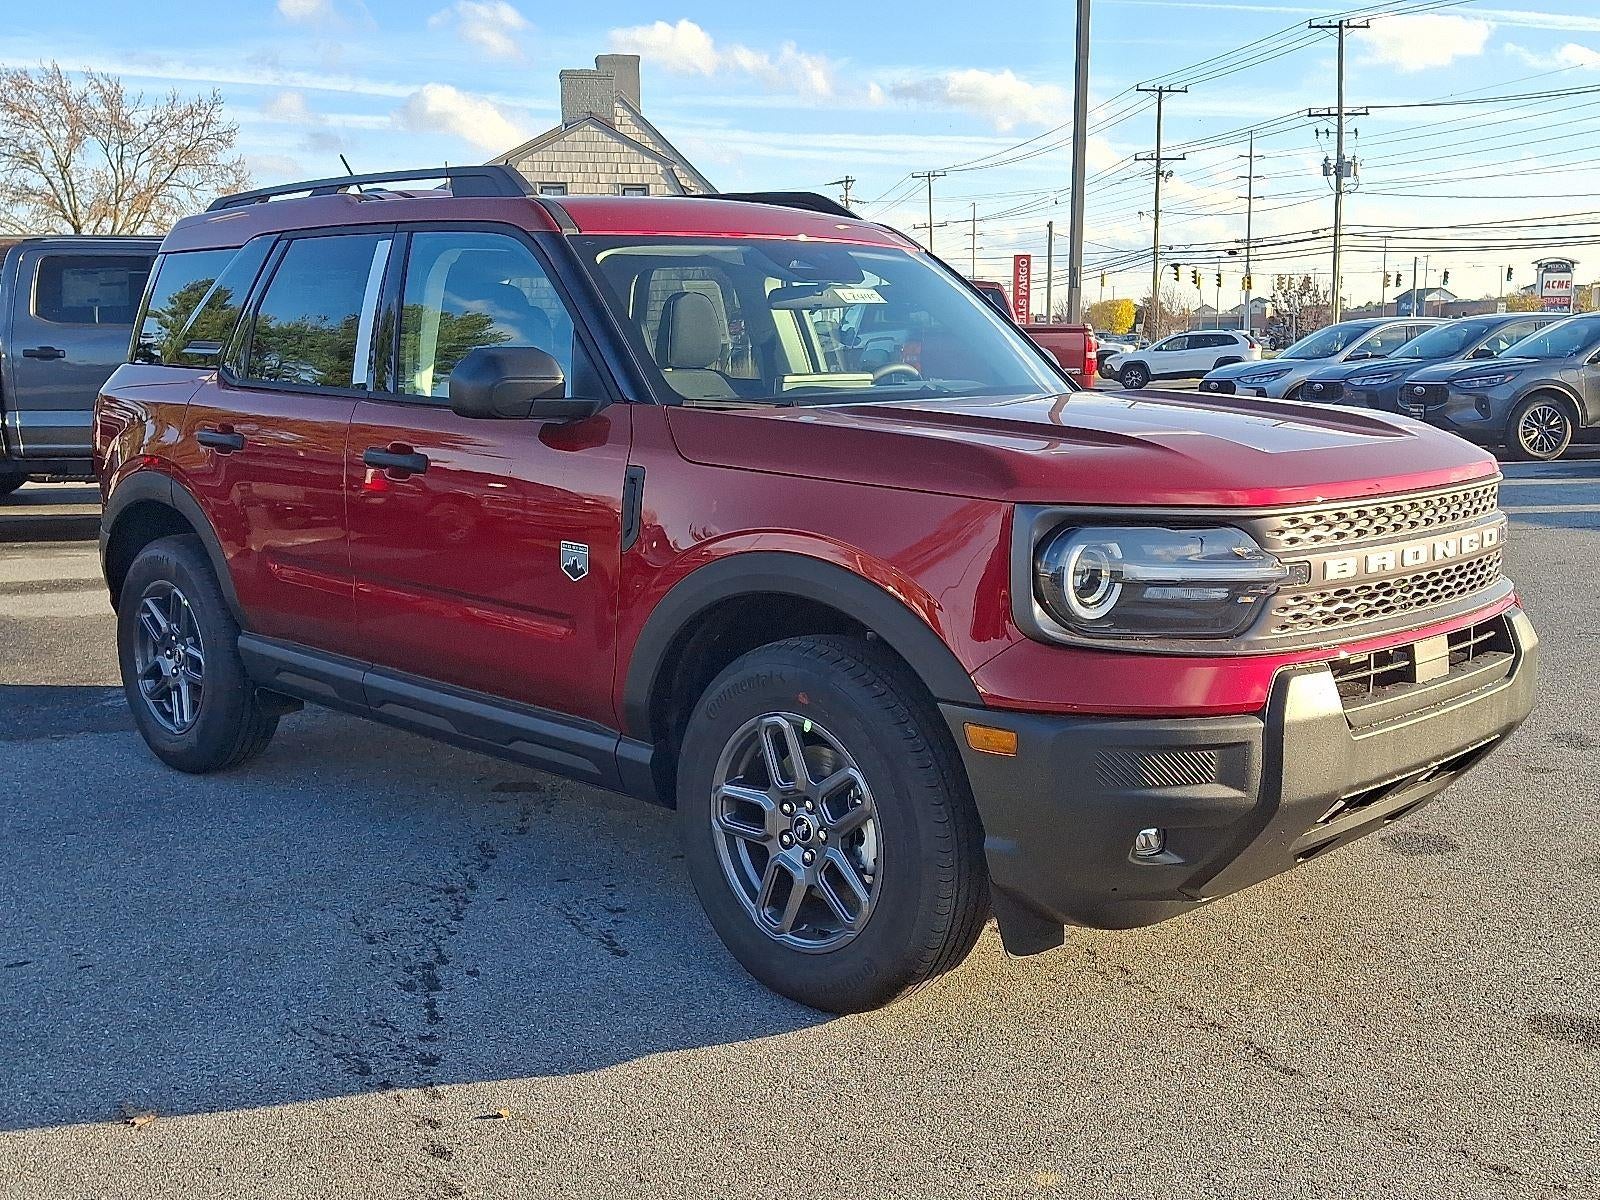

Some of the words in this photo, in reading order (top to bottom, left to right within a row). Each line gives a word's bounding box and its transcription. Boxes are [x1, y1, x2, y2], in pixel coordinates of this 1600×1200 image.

[1019, 258, 1028, 296] FARGO
[1544, 280, 1571, 290] ACME
[1019, 298, 1027, 325] ELLS
[1543, 297, 1569, 305] STAPLES
[1323, 527, 1498, 581] BRONCO
